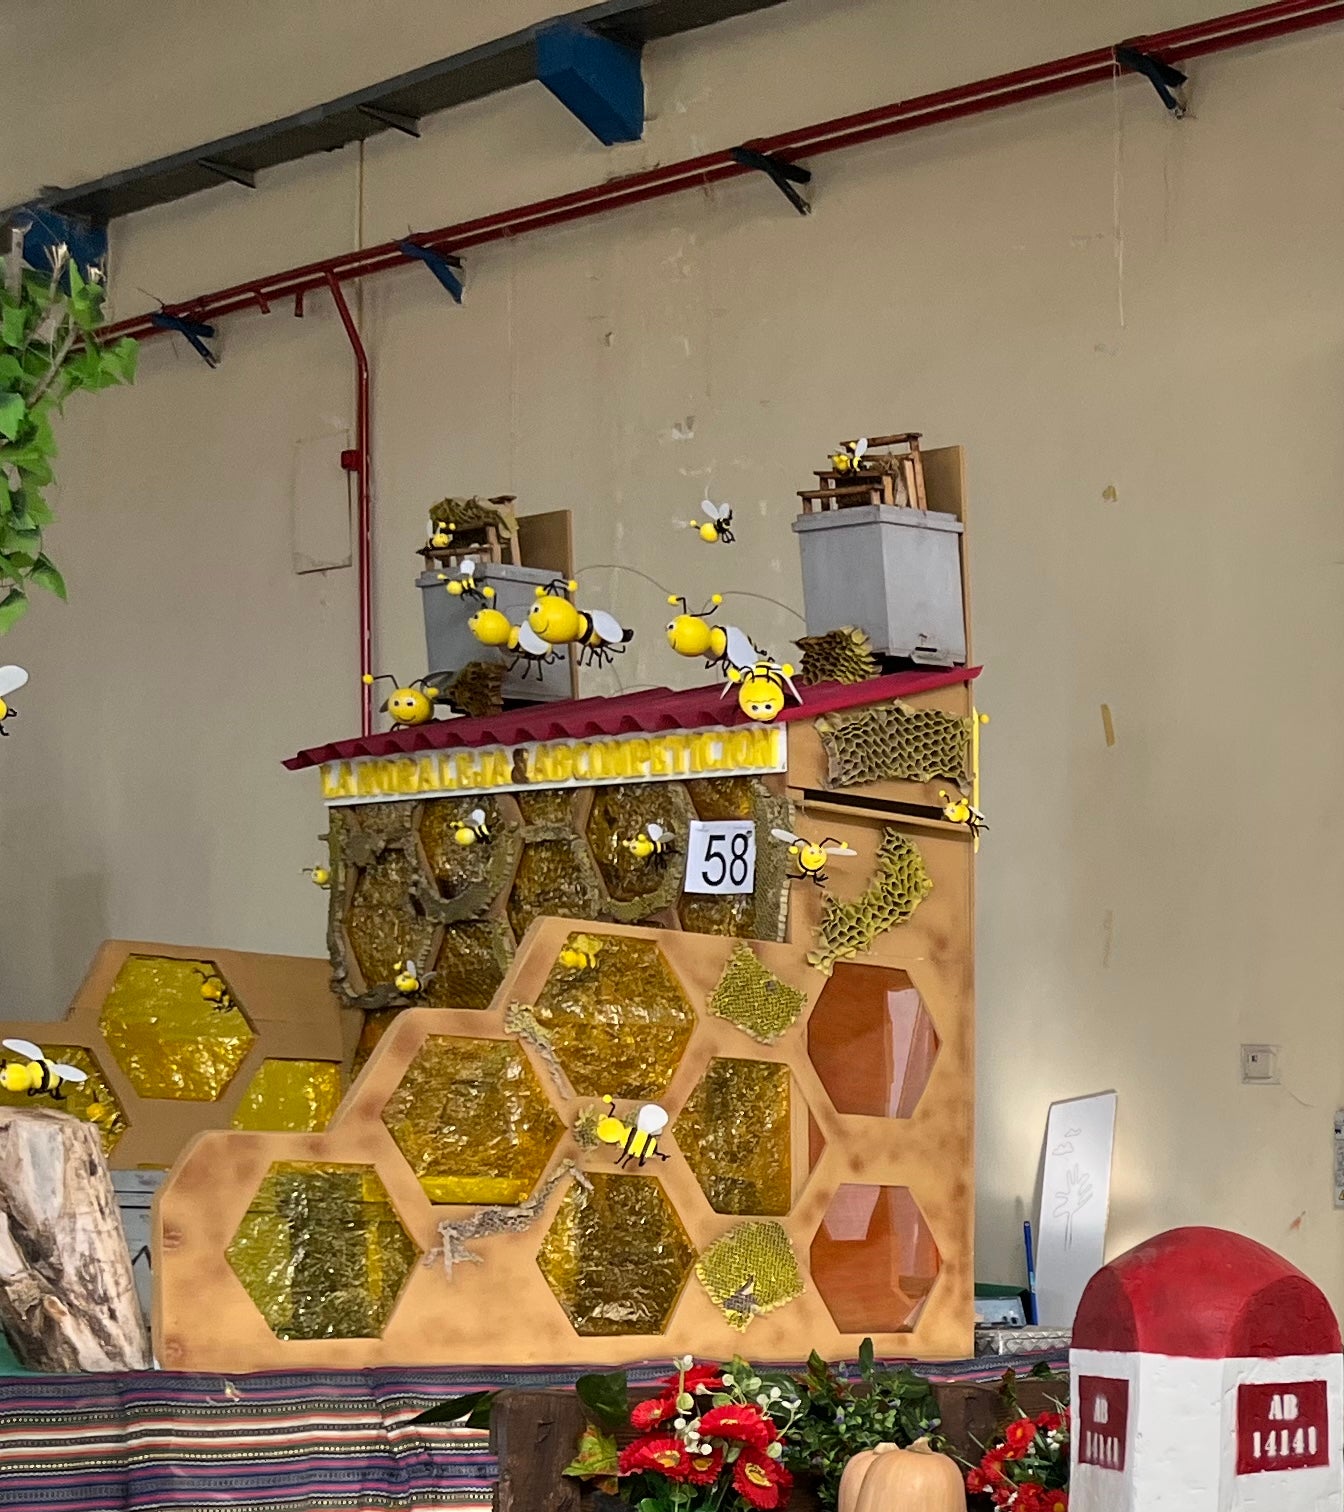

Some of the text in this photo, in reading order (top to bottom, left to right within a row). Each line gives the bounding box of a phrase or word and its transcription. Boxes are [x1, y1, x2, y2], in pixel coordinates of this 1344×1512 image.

[702, 832, 749, 887] 58
[1268, 1393, 1299, 1420] AB
[1252, 1426, 1318, 1460] 14141
